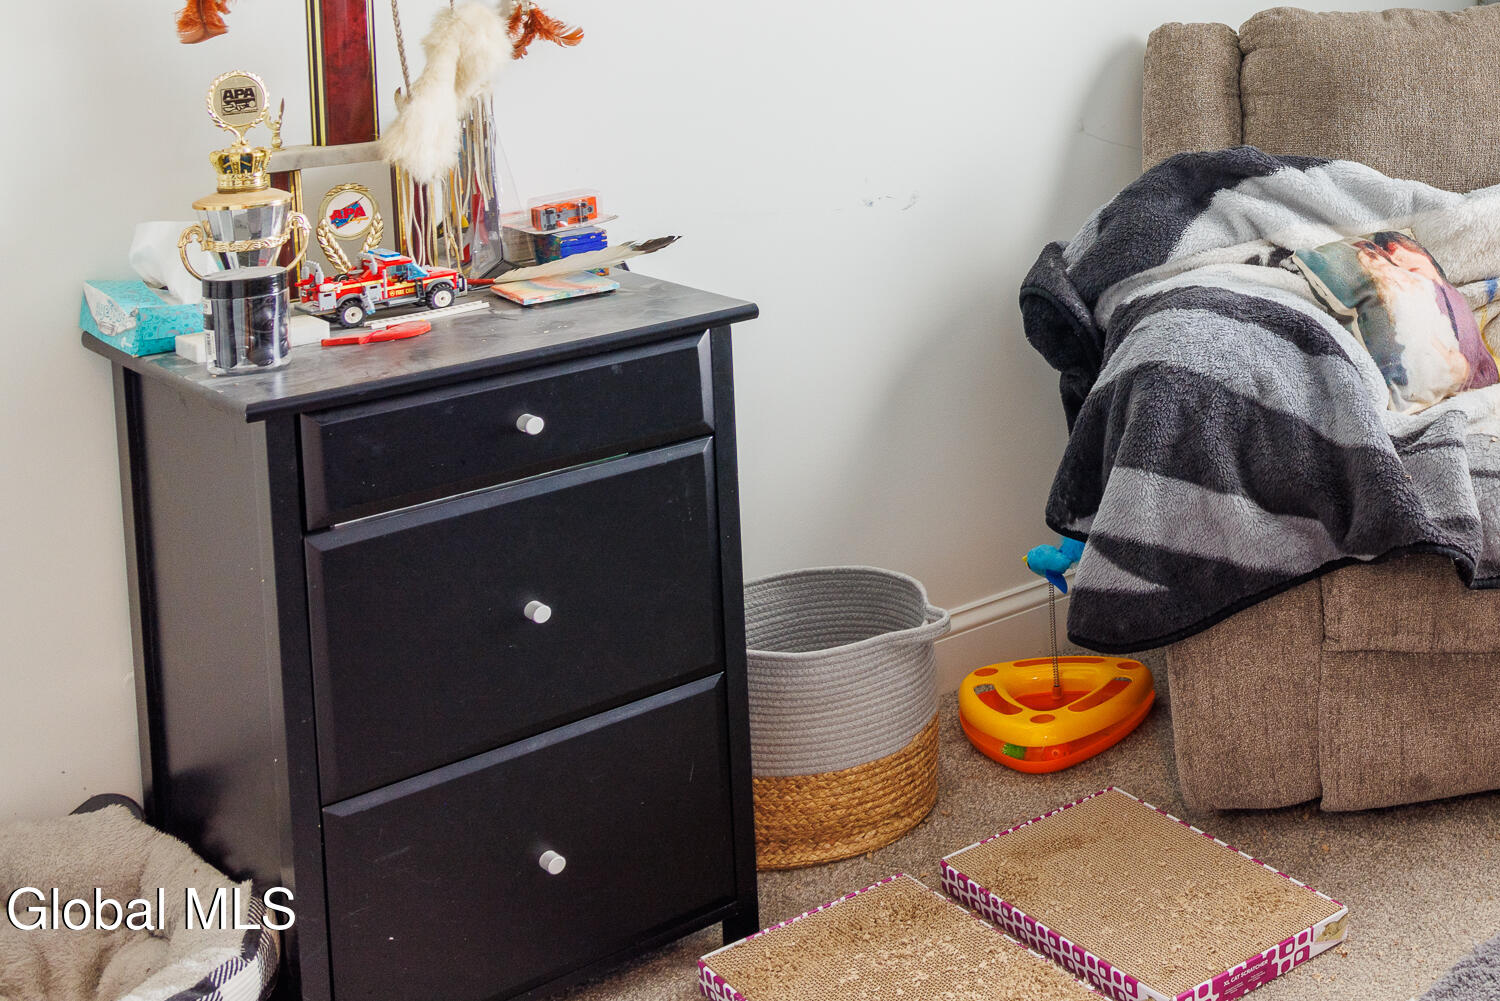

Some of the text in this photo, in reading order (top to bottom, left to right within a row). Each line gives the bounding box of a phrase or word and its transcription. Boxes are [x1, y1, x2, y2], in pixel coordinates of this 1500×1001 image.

[223, 88, 255, 100] APA
[329, 204, 366, 221] APA
[1223, 979, 1231, 987] XL
[1230, 974, 1241, 983] CAT
[1240, 959, 1269, 979] SCRATCHER
